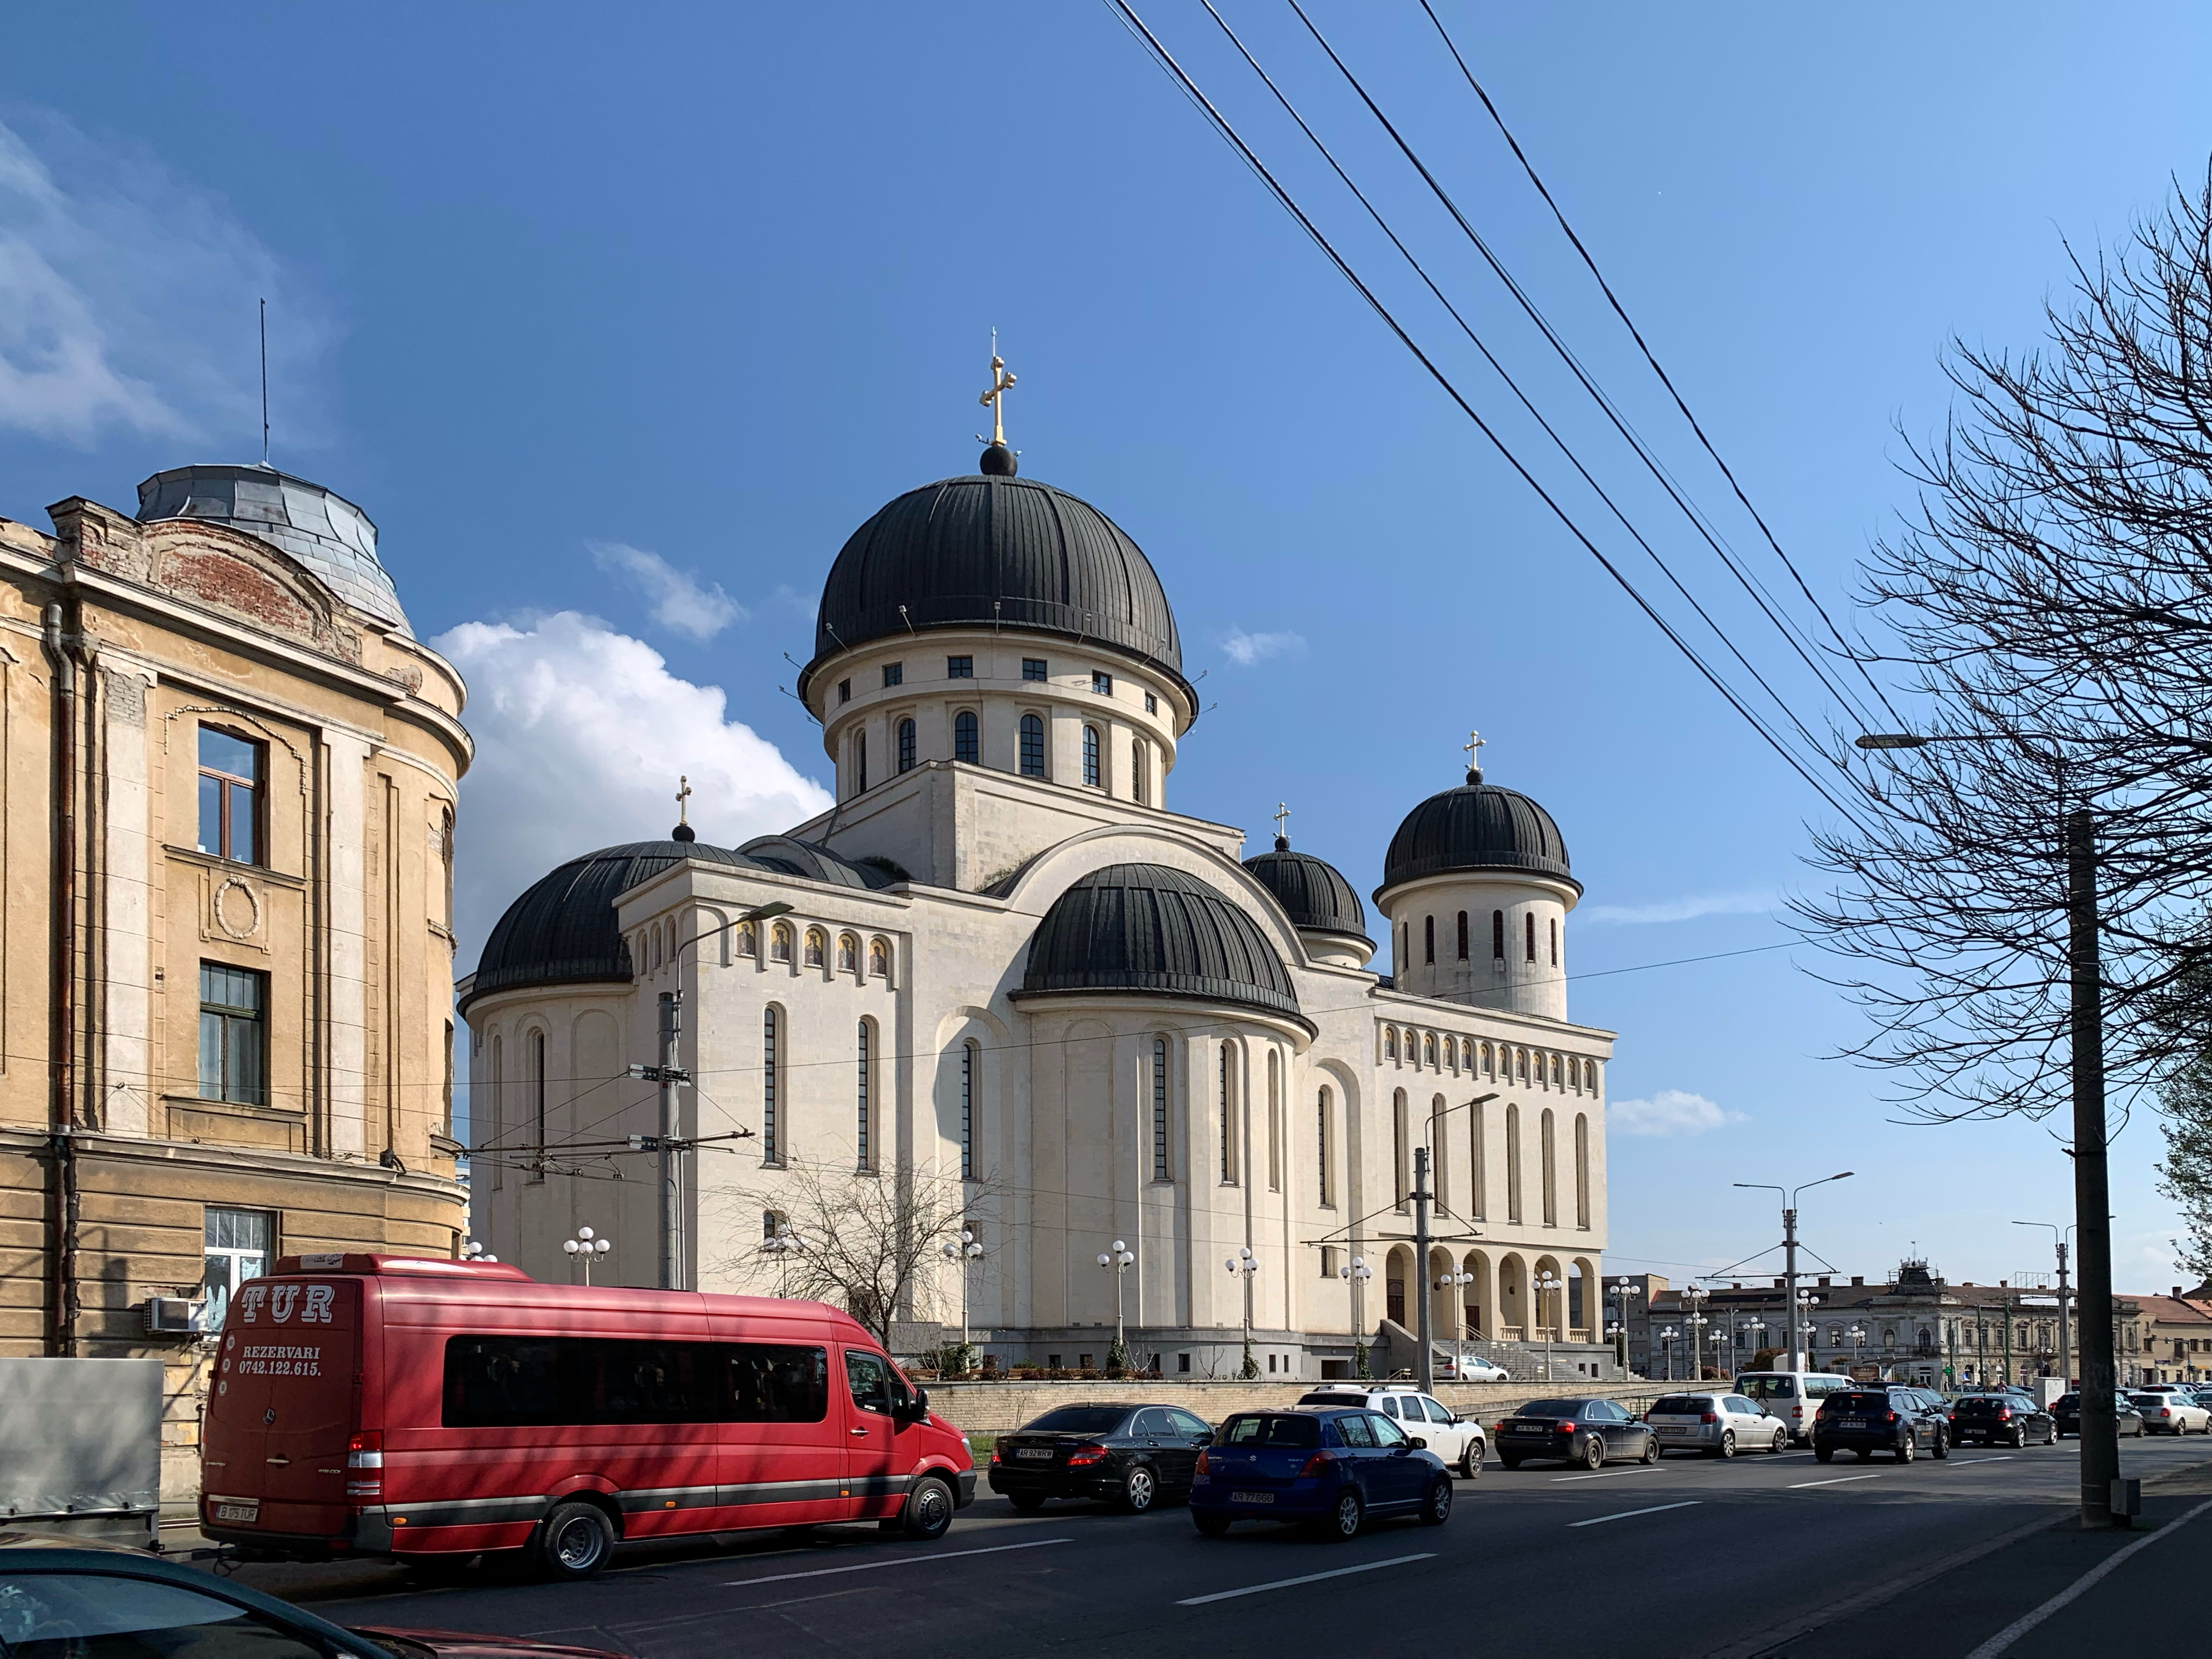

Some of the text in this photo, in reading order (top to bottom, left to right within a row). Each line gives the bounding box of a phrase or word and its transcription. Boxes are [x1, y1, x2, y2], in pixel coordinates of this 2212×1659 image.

[241, 1285, 335, 1323] TUR
[242, 1346, 321, 1359] REZERVARI
[1233, 1492, 1243, 1501] AR
[221, 1506, 227, 1517] B
